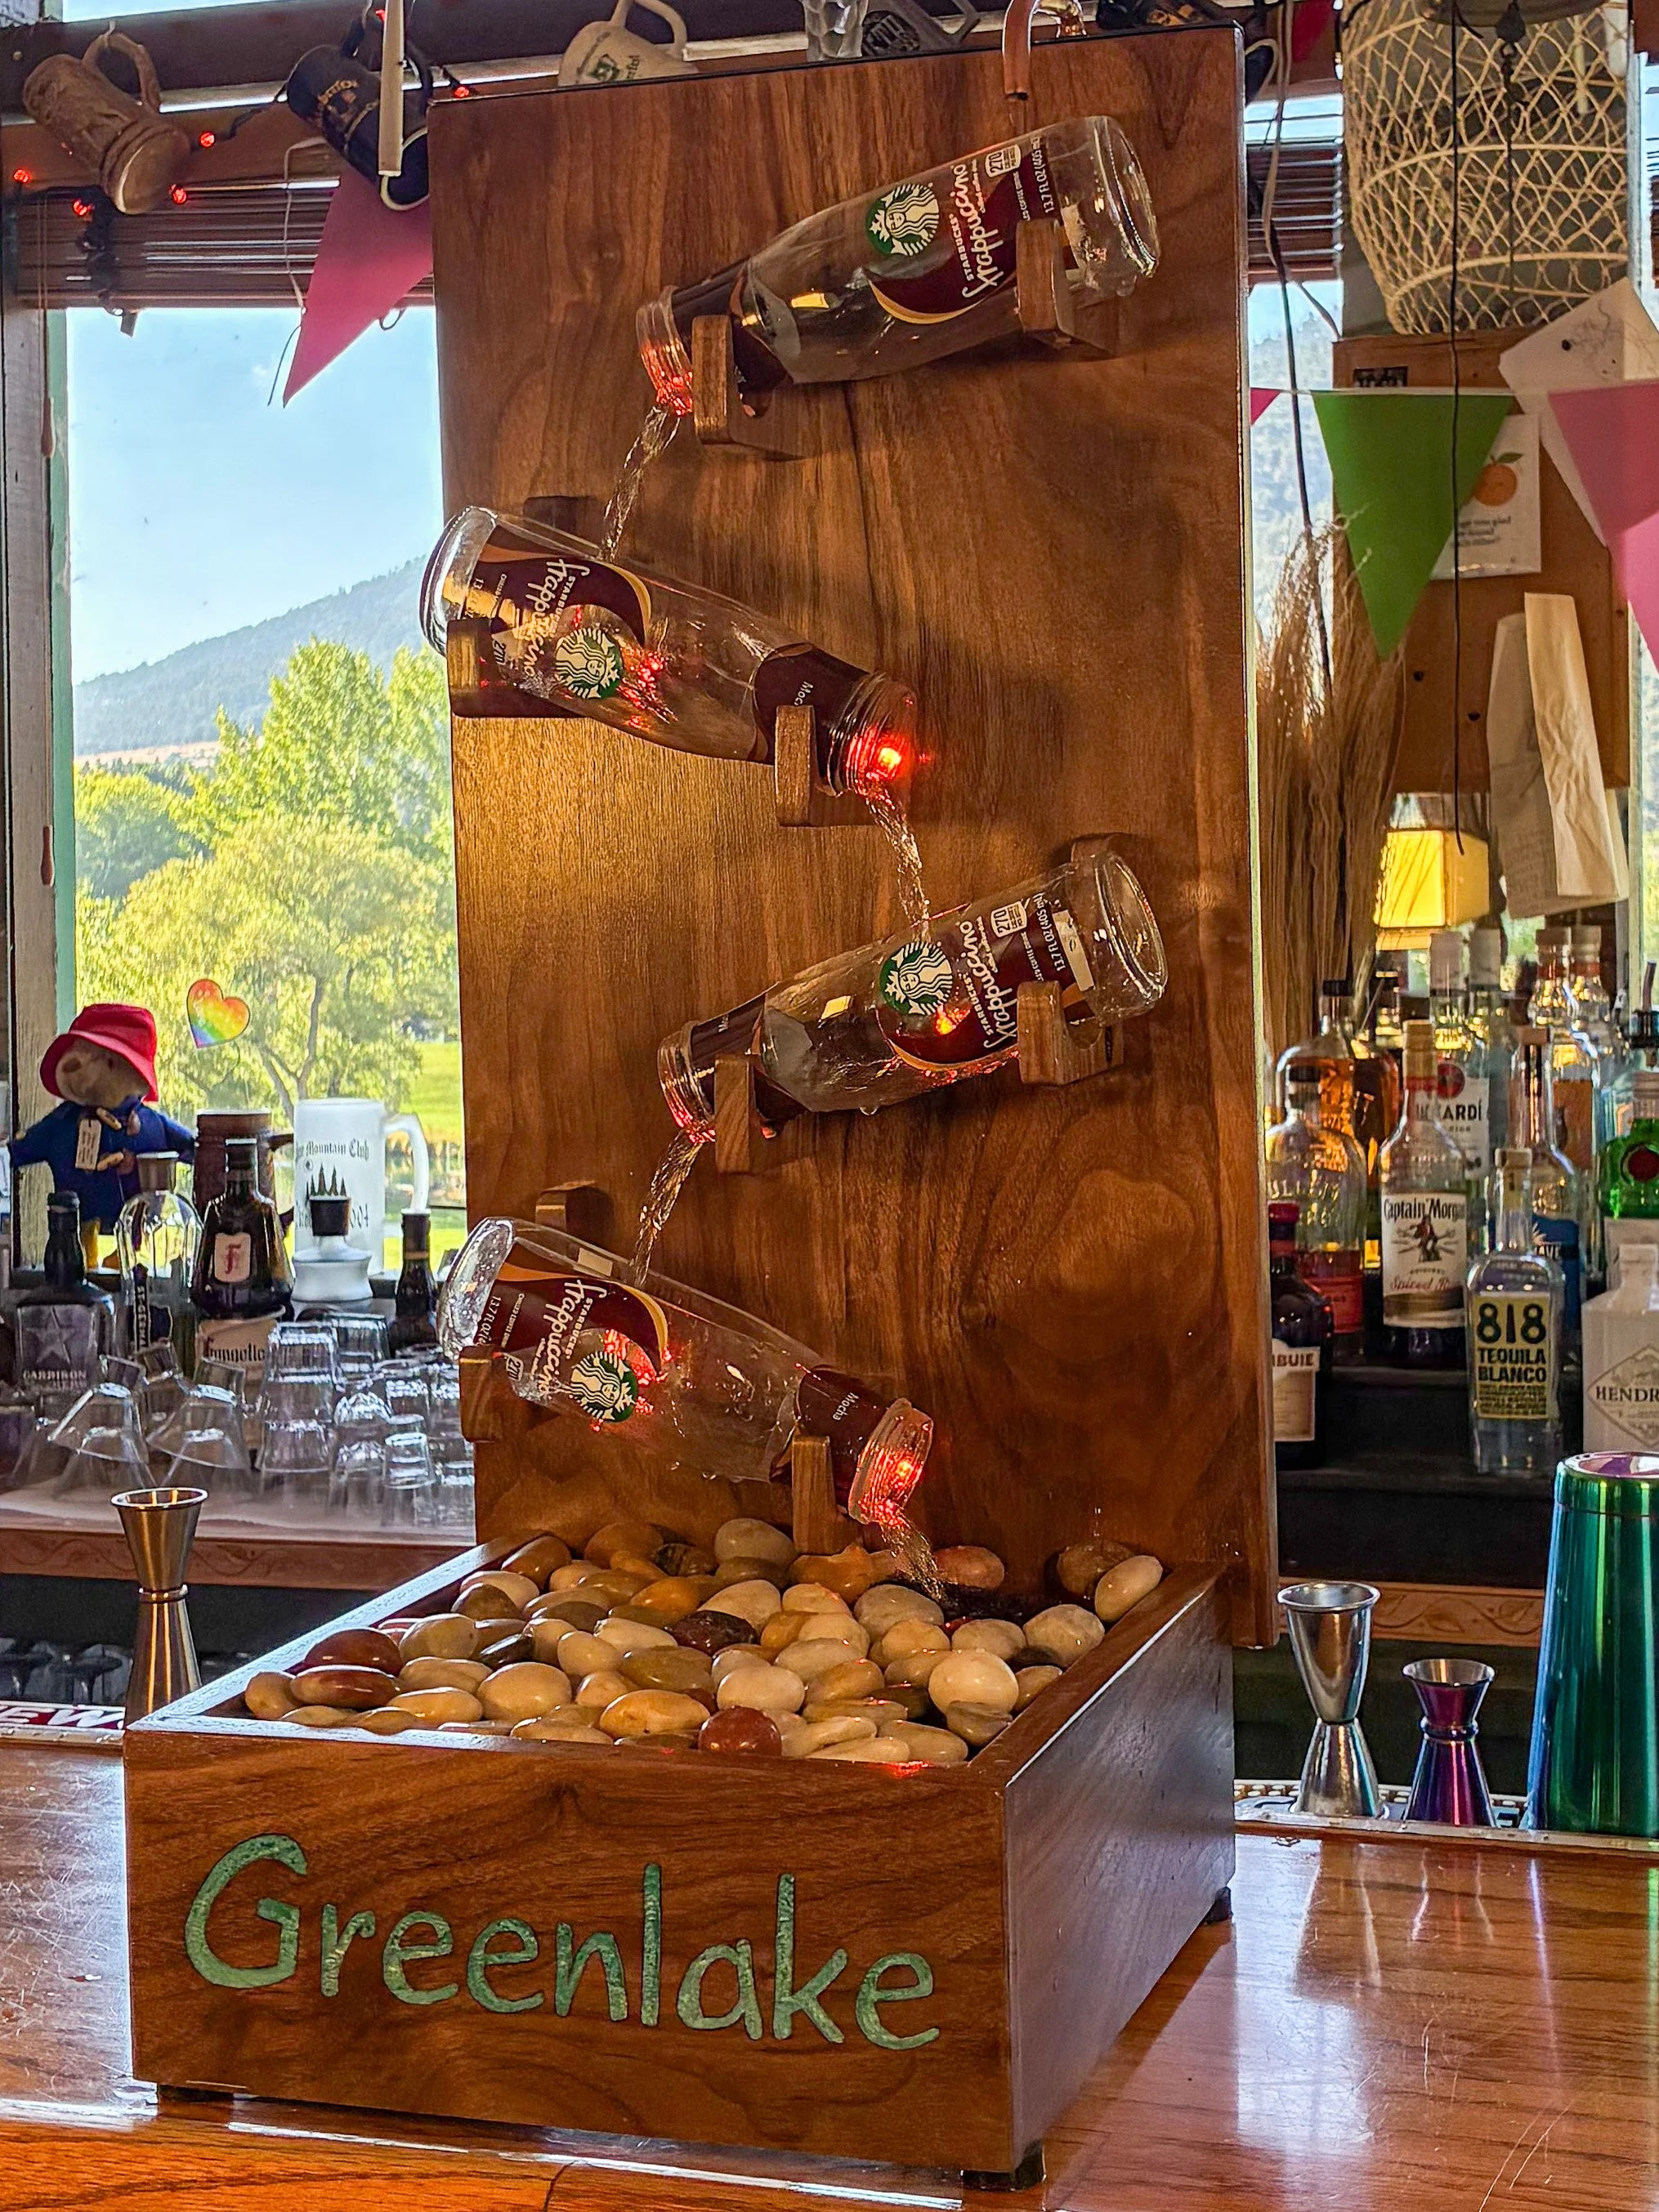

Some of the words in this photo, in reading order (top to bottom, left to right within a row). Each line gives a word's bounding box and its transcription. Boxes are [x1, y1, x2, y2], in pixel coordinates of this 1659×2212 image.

[988, 151, 1004, 173] 270
[794, 681, 814, 706] Moc
[994, 909, 1011, 934] 270
[306, 1141, 347, 1157] Mountain
[1384, 1197, 1425, 1223] Captain
[537, 1279, 608, 1393] Frappuccino
[566, 1298, 594, 1358] STARBUCKS
[1476, 1303, 1547, 1344] 818
[1478, 1348, 1547, 1365] TEQUILA
[1478, 1365, 1547, 1383] BLANCO
[832, 1392, 859, 1421] Mocha
[184, 1832, 941, 2049] Greenlake
